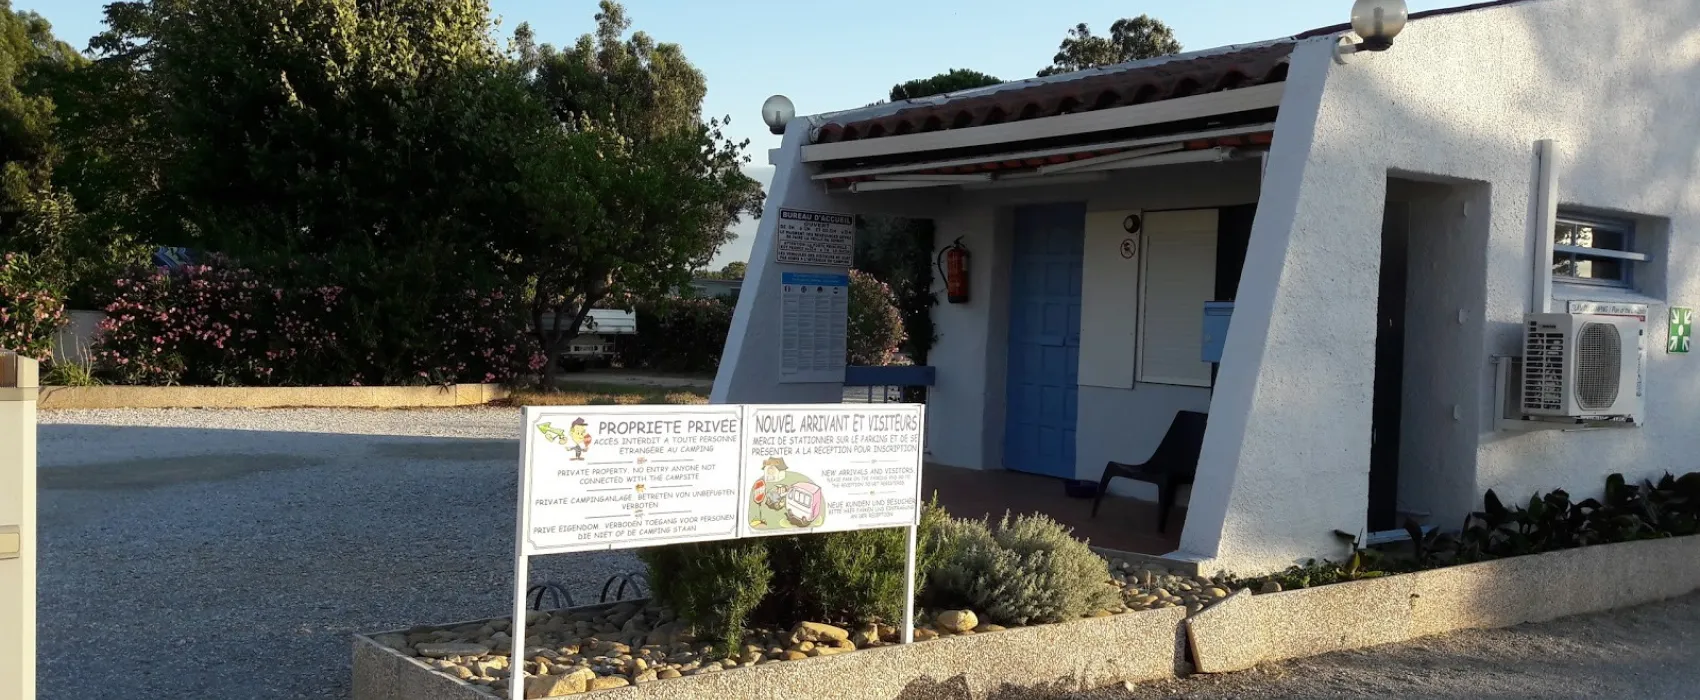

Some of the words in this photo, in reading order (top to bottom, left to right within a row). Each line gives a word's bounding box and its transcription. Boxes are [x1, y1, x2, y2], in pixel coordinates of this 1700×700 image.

[782, 211, 812, 220] BUREAU
[814, 214, 851, 224] D'ACCUEIL
[599, 421, 682, 434] PROPRIETE
[688, 418, 737, 433] PRIVÉE
[756, 414, 796, 434] NOUVEL
[800, 414, 850, 433] ARRIVANT
[852, 414, 866, 432] ET
[868, 414, 918, 432] VISITEURS
[622, 436, 660, 445] INTERDIT
[672, 435, 698, 444] TOUTE
[700, 434, 737, 443] PERSONNE
[752, 436, 775, 446] MERCI
[778, 436, 786, 446] DE
[789, 435, 834, 445] STATIONNER
[836, 435, 849, 444] SUR
[860, 434, 888, 443] PARKING
[890, 434, 898, 443] ET
[900, 434, 908, 443] DE
[680, 445, 714, 453] CAMPING
[802, 446, 811, 455] LA
[854, 445, 872, 454] POUR
[874, 444, 918, 453] INSCRIPTION
[557, 468, 590, 477] PRIVATE
[580, 476, 624, 485] CONNECTED
[666, 473, 700, 481] CAMPSITE
[535, 498, 568, 506] PRIVATE
[638, 491, 674, 500] BETRETEN
[692, 489, 736, 498] UNBEFUGTEN
[622, 502, 659, 510] VERBOTEN
[846, 500, 870, 508] KUNDEN
[533, 526, 556, 534] PRIVE
[604, 520, 642, 529] VERBODEN
[645, 518, 678, 526] TOEGANG
[700, 514, 735, 522] PERSONEN
[594, 530, 612, 538] NIET
[639, 526, 672, 535] CAMPING
